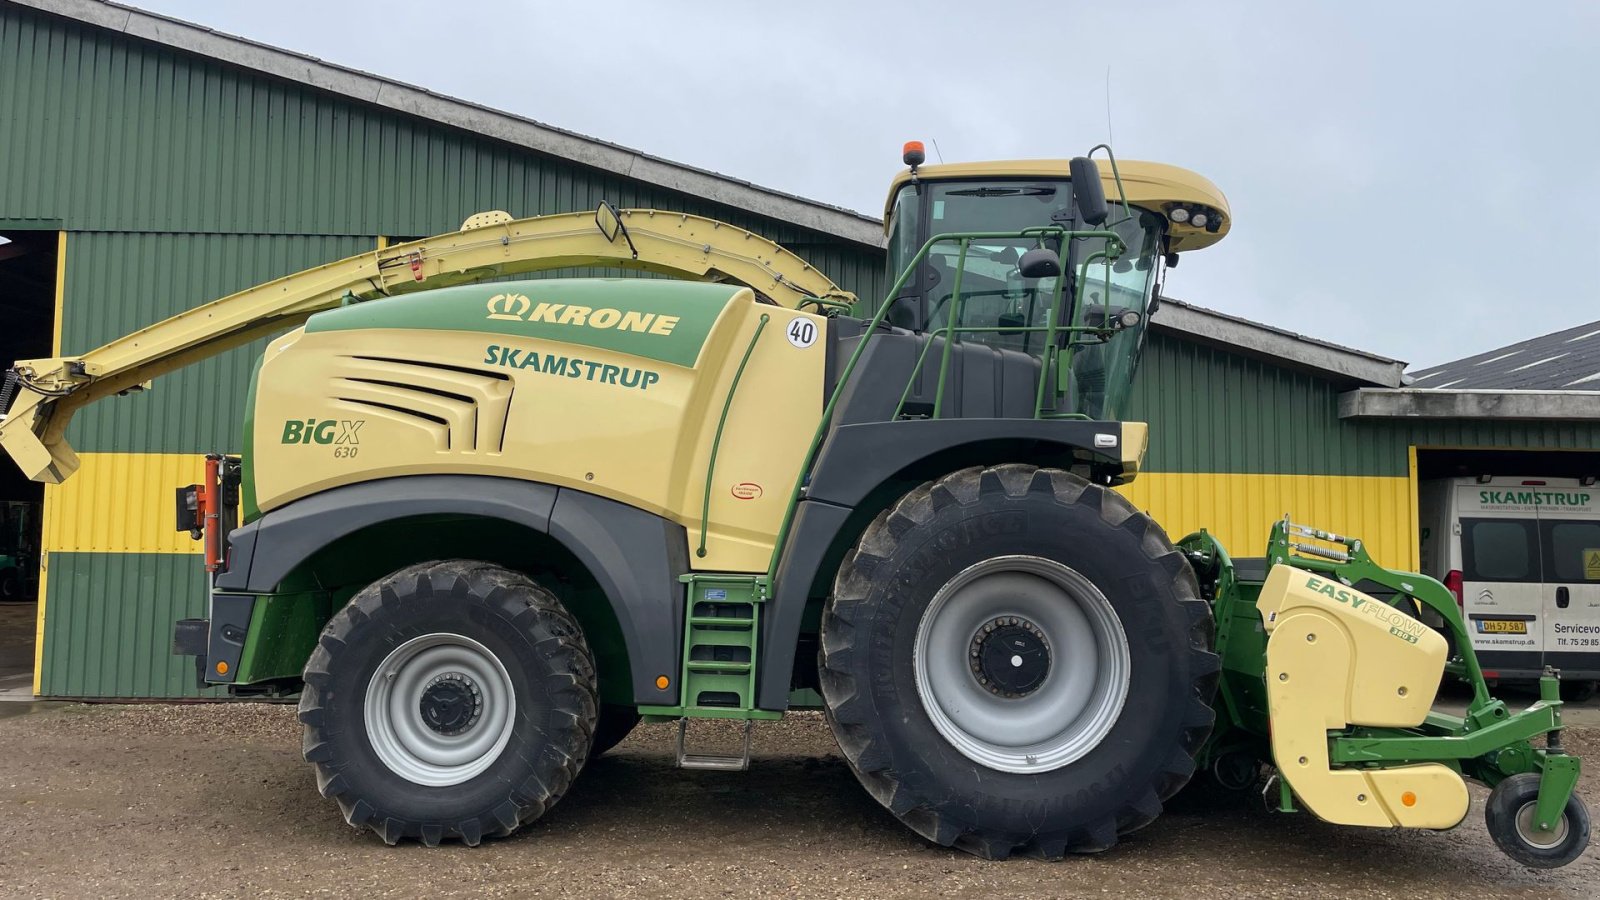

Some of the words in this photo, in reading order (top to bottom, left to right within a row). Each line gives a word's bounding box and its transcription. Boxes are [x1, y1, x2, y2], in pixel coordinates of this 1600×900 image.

[528, 302, 681, 336] KRONE
[790, 320, 813, 344] 40
[484, 344, 660, 390] SKAMSTRUP
[334, 446, 358, 459] 630
[1480, 491, 1591, 506] SKAMSTRUP
[1483, 622, 1496, 631] DH
[1497, 622, 1507, 631] 57
[1509, 622, 1524, 631] 587
[1554, 623, 1600, 634] Servicevo
[1474, 638, 1536, 646] www.skamstrup.dk
[1557, 638, 1569, 646] Tlf.
[1570, 638, 1579, 646] 75
[1580, 638, 1589, 646] 29
